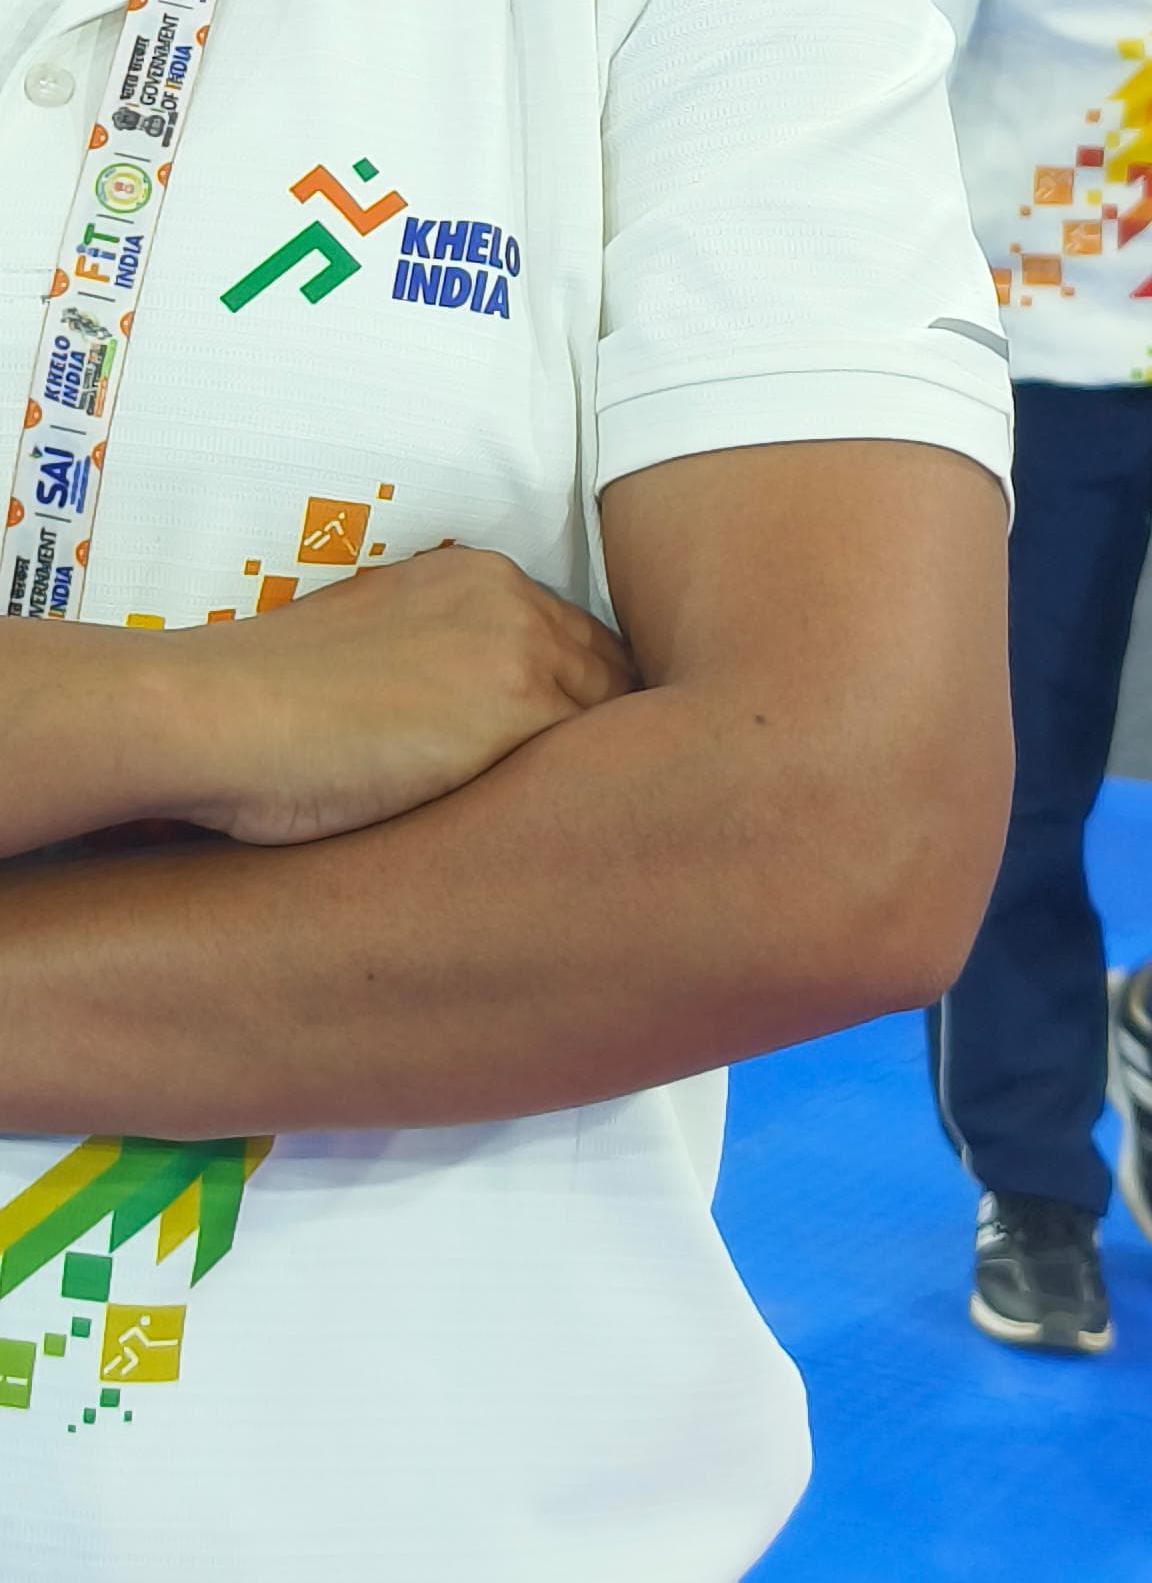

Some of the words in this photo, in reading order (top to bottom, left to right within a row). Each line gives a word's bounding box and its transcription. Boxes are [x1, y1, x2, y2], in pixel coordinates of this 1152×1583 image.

[139, 12, 179, 106] GOVERNMENT
[164, 45, 193, 91] INDIA
[160, 90, 179, 111] OF
[114, 235, 145, 289] INDIA
[400, 216, 521, 278] KHELO
[391, 259, 511, 320] INDIA
[44, 335, 70, 403] KHELO
[61, 350, 86, 410] INDIA
[36, 446, 75, 508] SAI
[29, 527, 57, 618] VERNMENT
[48, 566, 74, 619] INDIA
